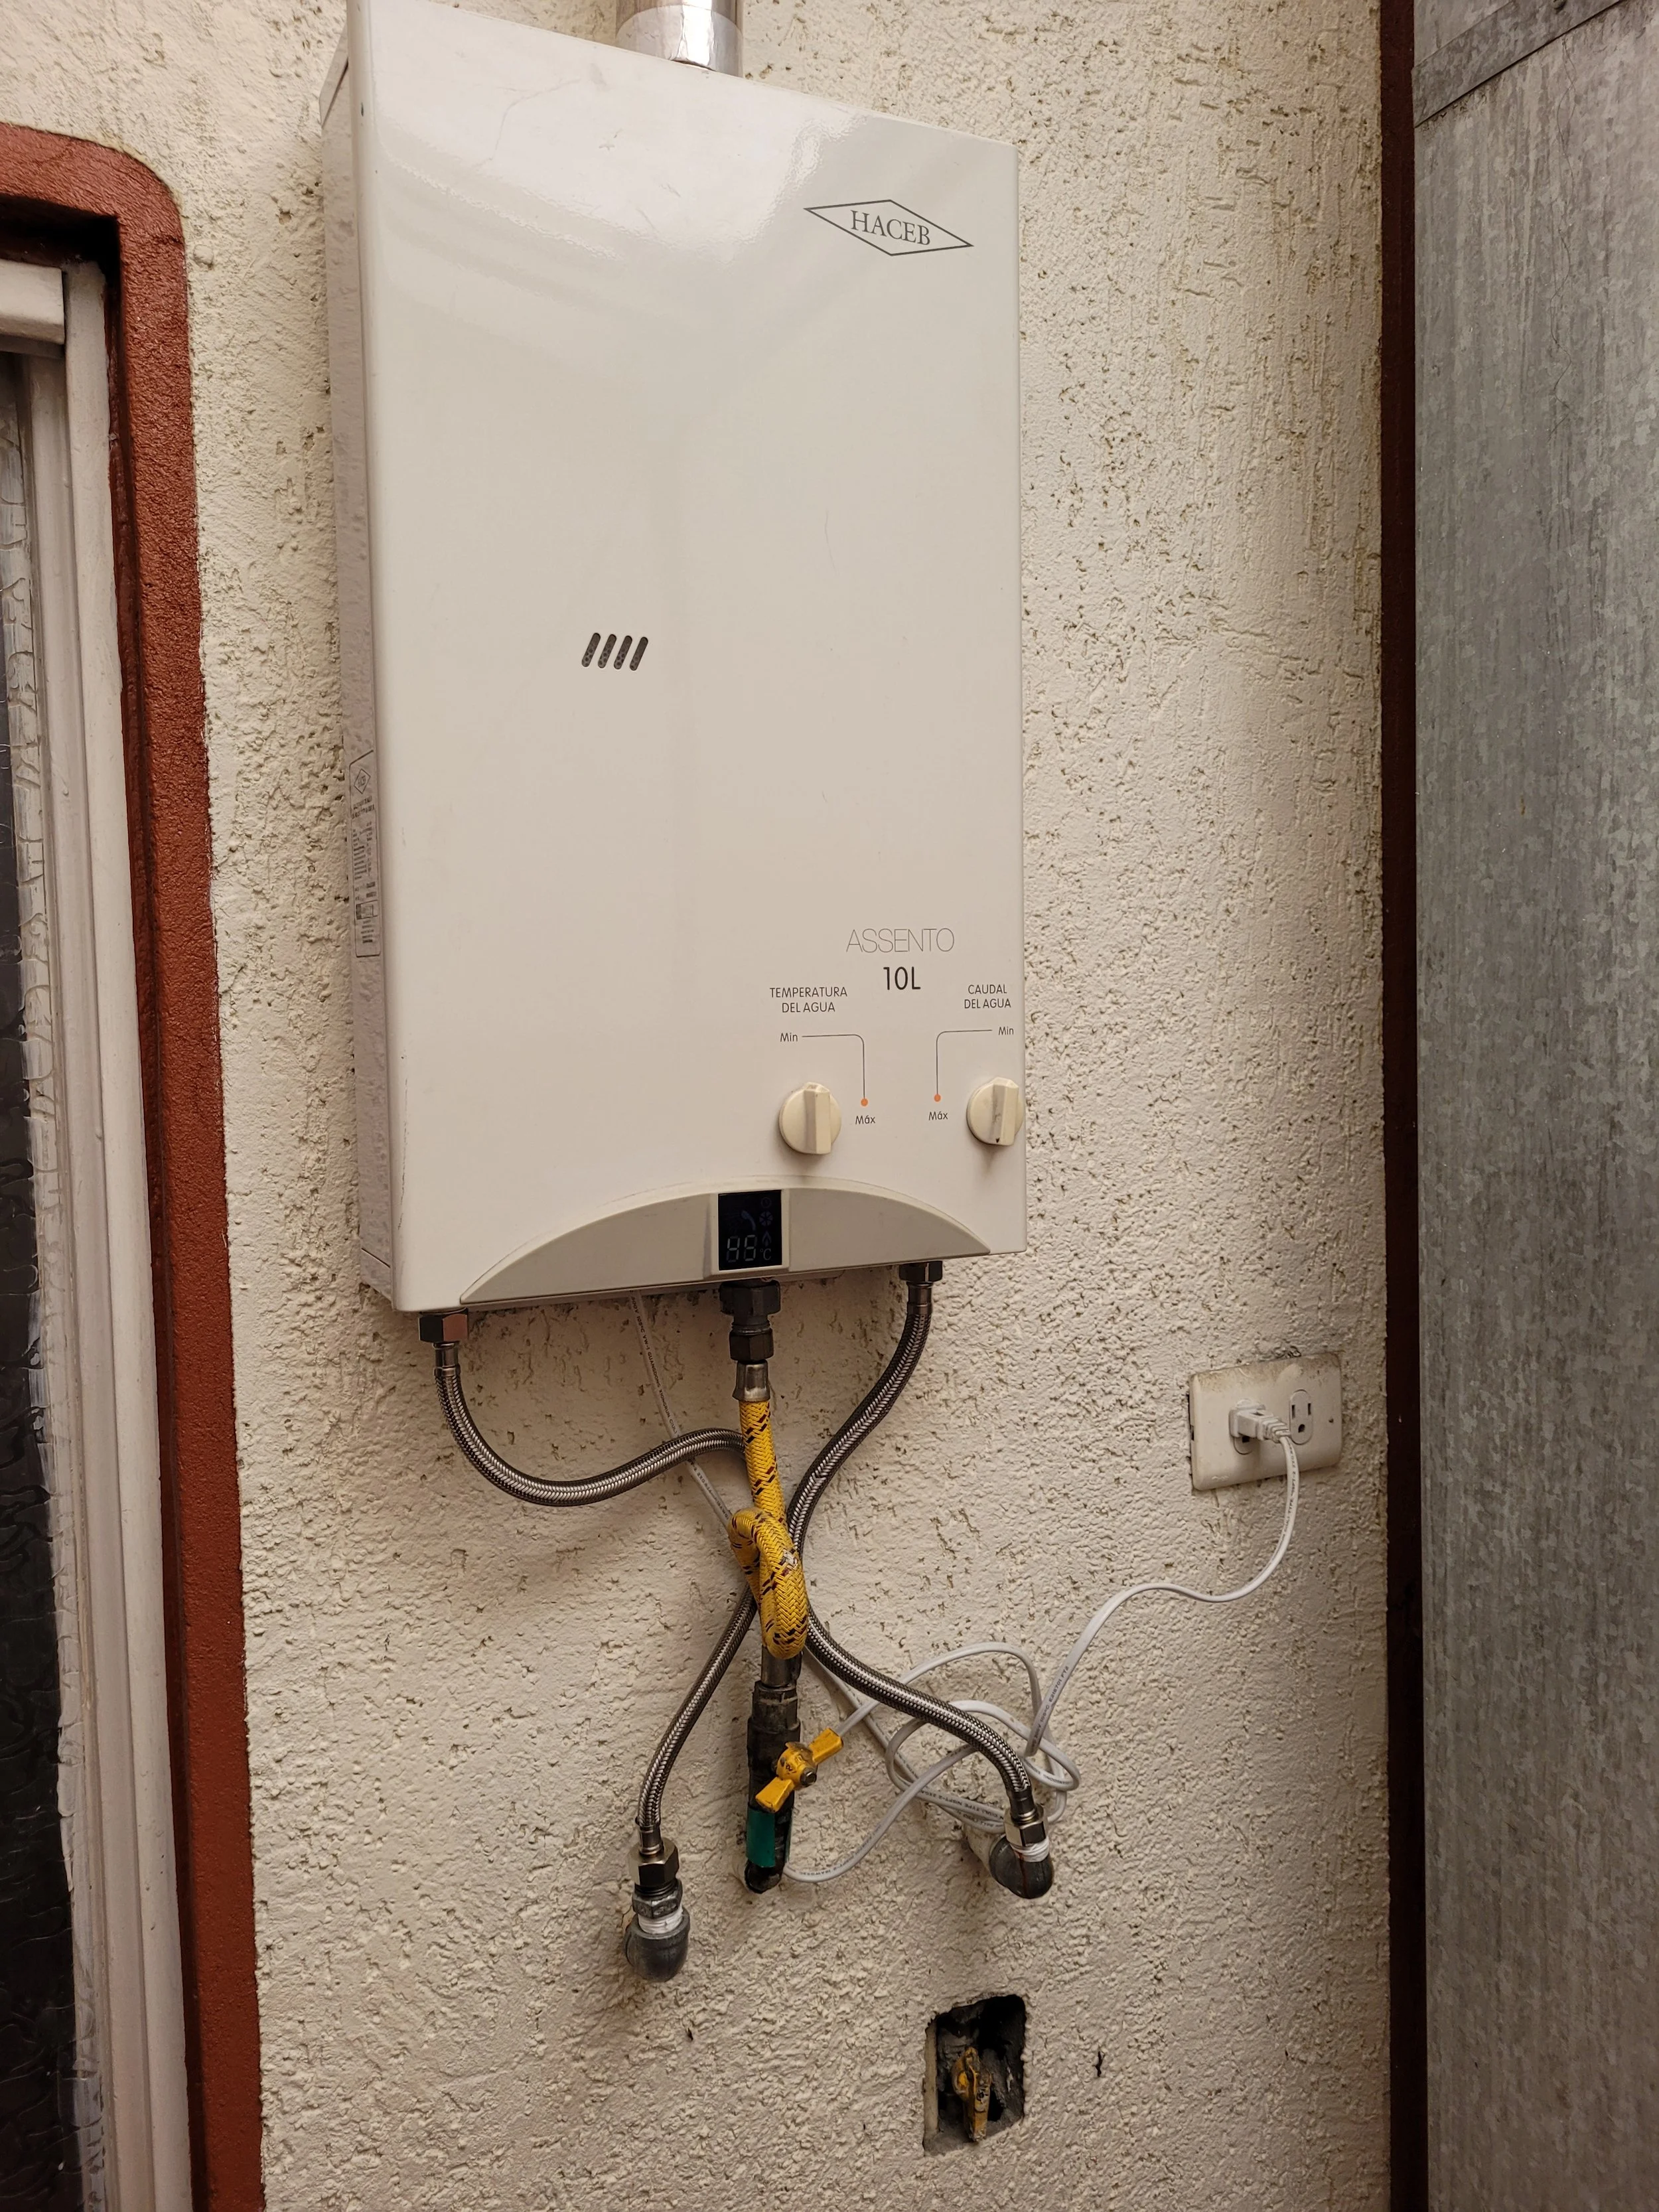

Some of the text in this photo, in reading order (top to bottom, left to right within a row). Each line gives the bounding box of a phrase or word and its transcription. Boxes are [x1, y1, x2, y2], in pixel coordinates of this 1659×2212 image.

[850, 210, 930, 245] HACEB
[846, 928, 954, 952] ASSENTO
[883, 966, 921, 990] 10L
[770, 986, 847, 997] TEMPERATURA
[968, 984, 1007, 994] CAUDAL
[782, 1001, 835, 1013] DEL AGUA
[964, 998, 1011, 1009] DEL AGUA
[855, 1115, 876, 1125] Máx
[929, 1111, 948, 1120] Máx
